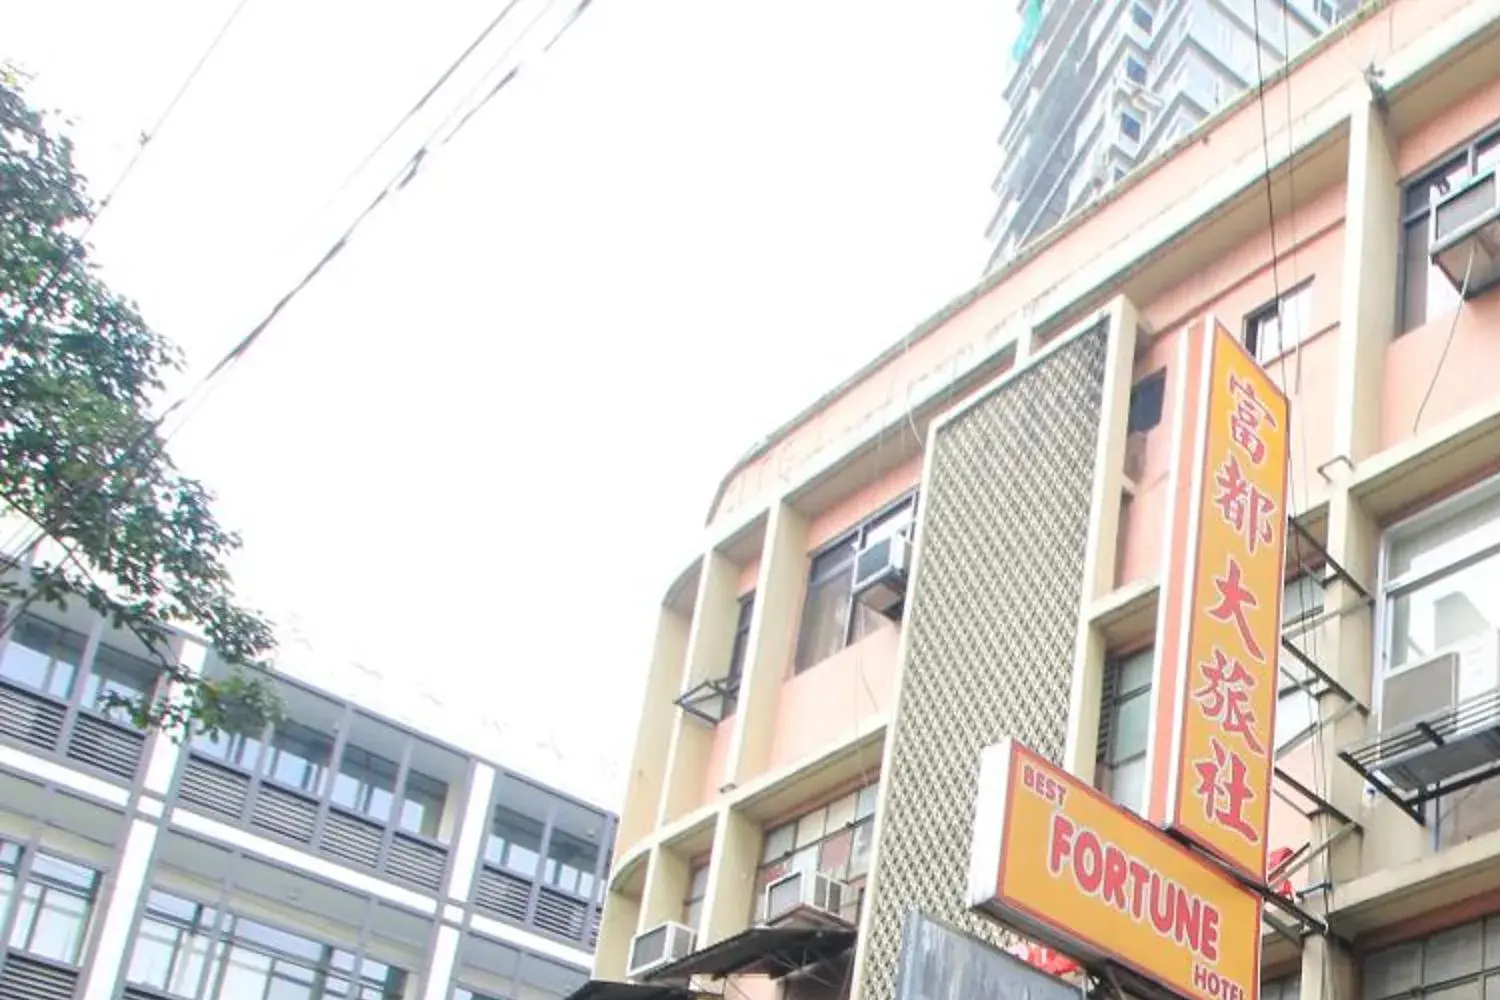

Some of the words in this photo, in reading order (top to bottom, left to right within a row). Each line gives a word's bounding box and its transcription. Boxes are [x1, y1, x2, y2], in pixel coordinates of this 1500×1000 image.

[1194, 371, 1276, 843] 富都大旅社
[1021, 762, 1067, 807] BEST
[1047, 812, 1222, 964] FORTUNE
